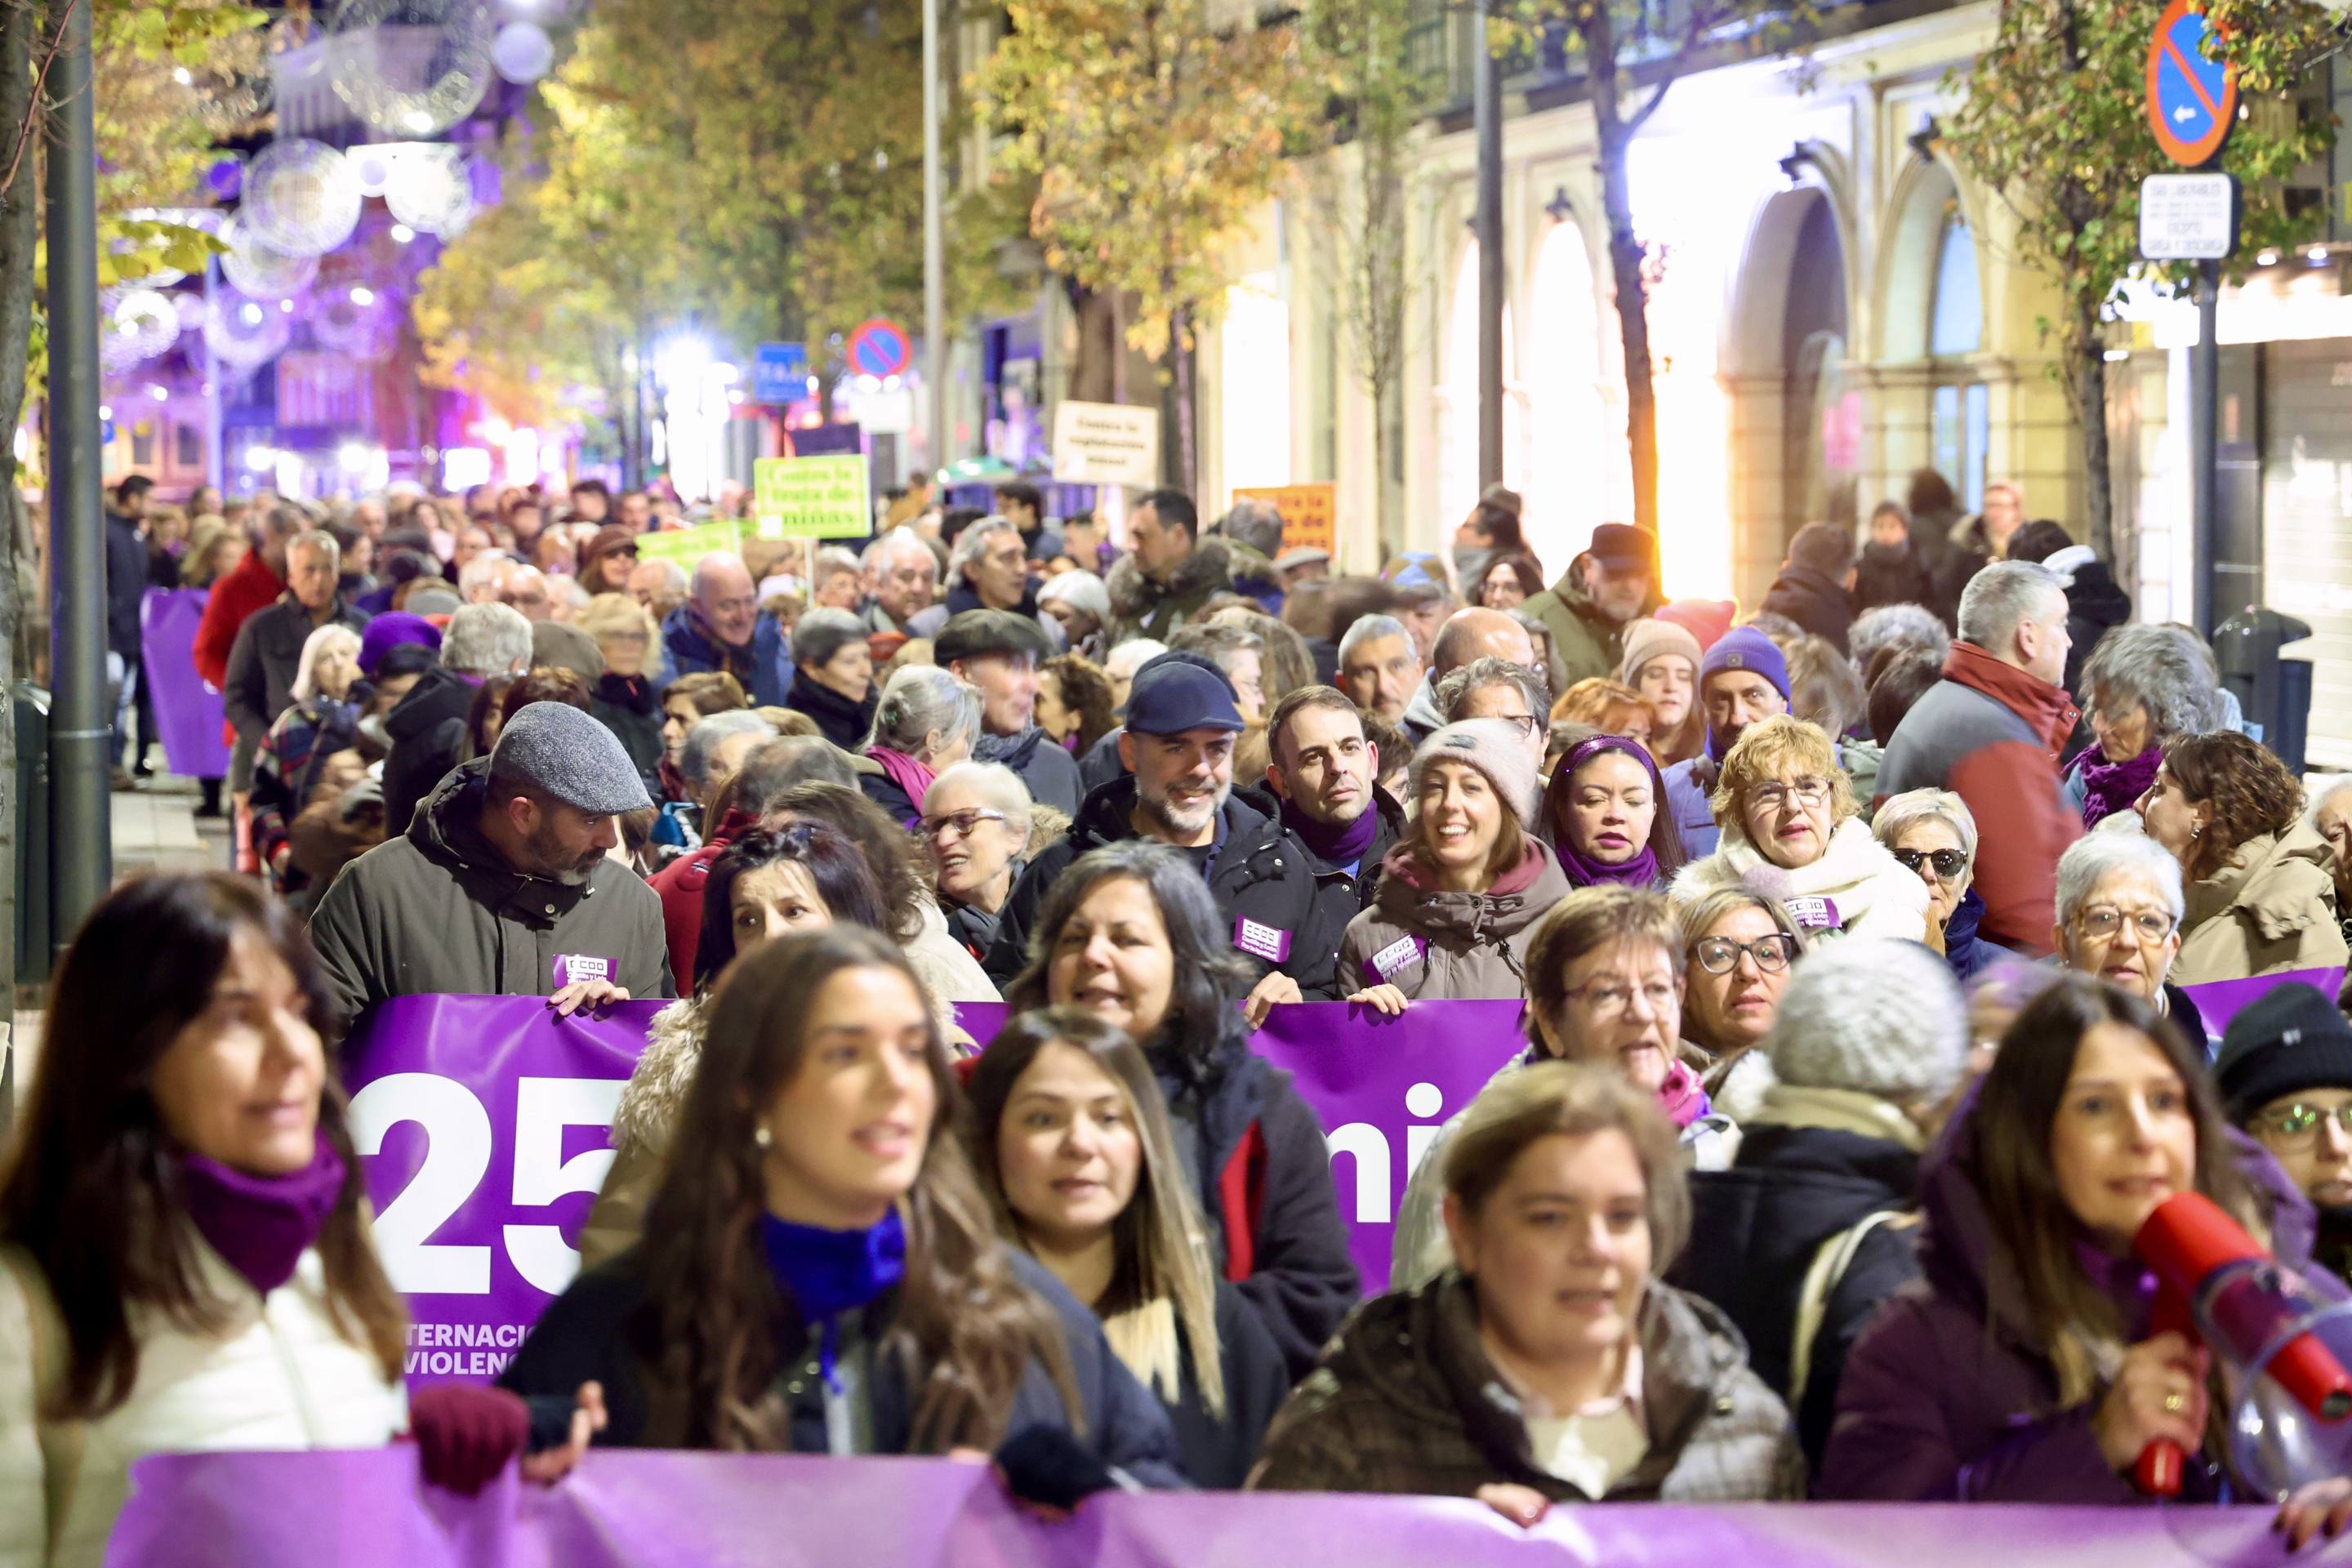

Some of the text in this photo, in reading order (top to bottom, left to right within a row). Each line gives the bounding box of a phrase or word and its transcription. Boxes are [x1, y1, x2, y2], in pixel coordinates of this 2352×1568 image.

[1309, 495, 1323, 507] la
[1303, 514, 1325, 528] de
[405, 1324, 537, 1348] TERNACI
[403, 1352, 519, 1375] VIOLEN
